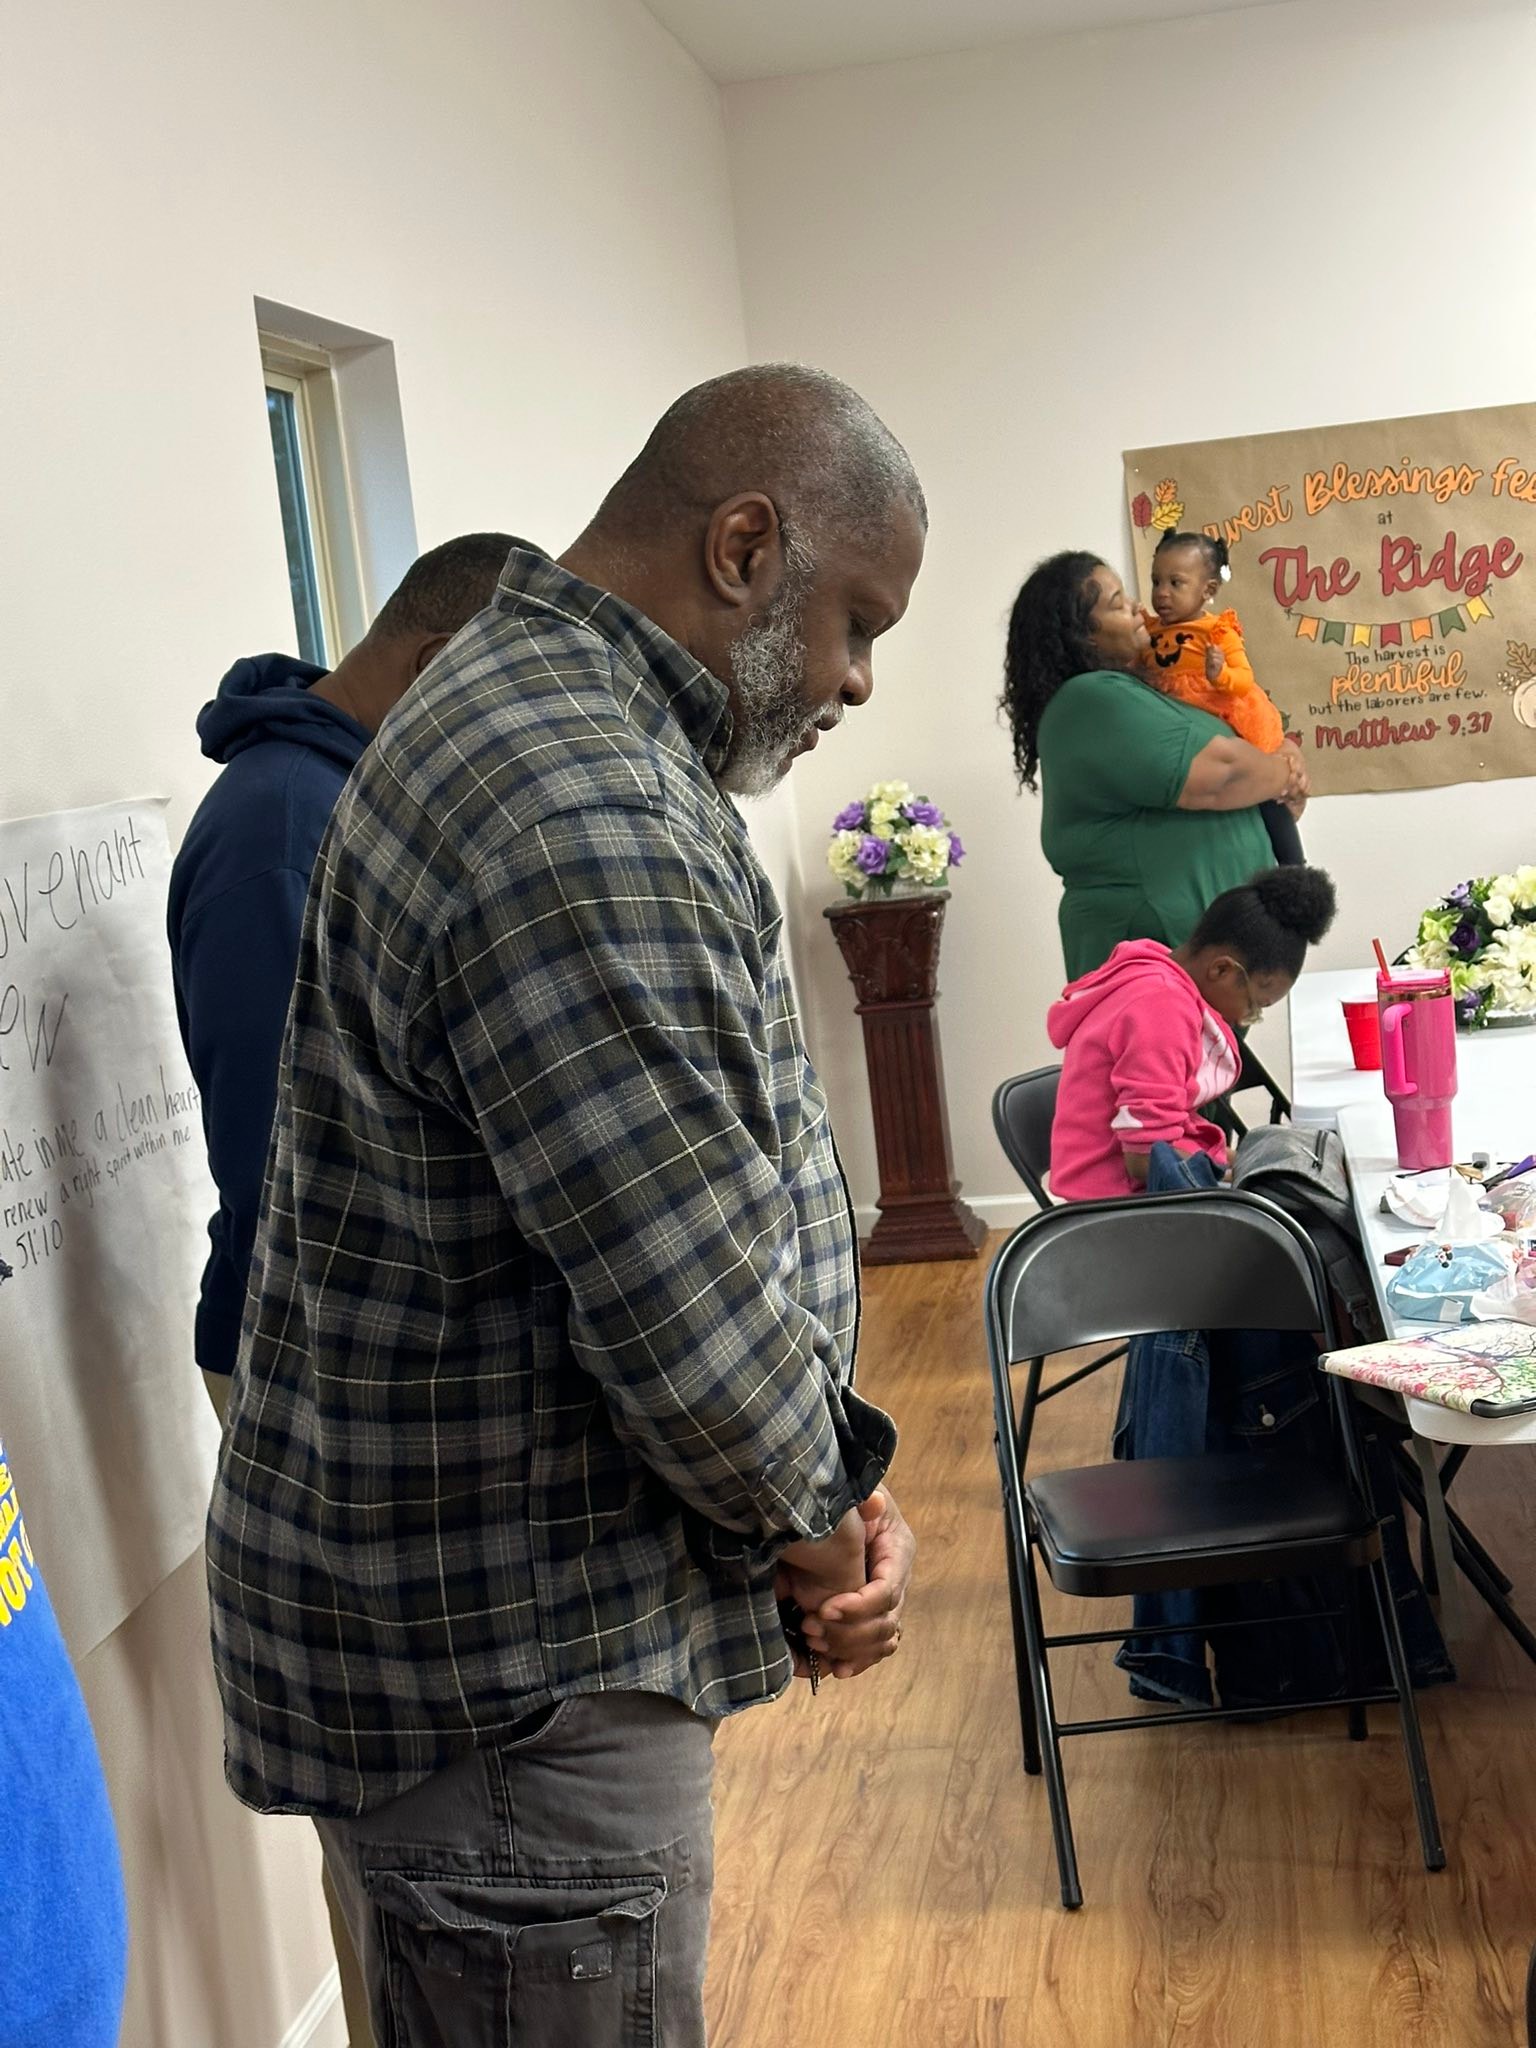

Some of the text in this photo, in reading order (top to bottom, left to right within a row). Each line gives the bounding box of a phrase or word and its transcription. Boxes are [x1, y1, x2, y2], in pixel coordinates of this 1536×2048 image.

[1202, 484, 1293, 549] rvest
[1304, 456, 1484, 517] Blessings
[1377, 509, 1394, 526] at
[1258, 530, 1524, 608] The Ridge
[1330, 649, 1468, 706] plentiful
[1345, 644, 1446, 665] The harvest is
[1309, 685, 1488, 717] but the laborers are few.
[1315, 711, 1493, 750] Matthew 9:37
[33, 1128, 56, 1169] in
[94, 1109, 108, 1142] a
[116, 1082, 159, 1142] clean
[159, 1065, 200, 1121] heart
[4, 1191, 48, 1228] renew
[60, 1182, 70, 1204] a
[72, 1157, 101, 1209] right
[133, 1131, 167, 1160] within
[172, 1126, 191, 1147] me
[16, 1219, 64, 1270] 51:10
